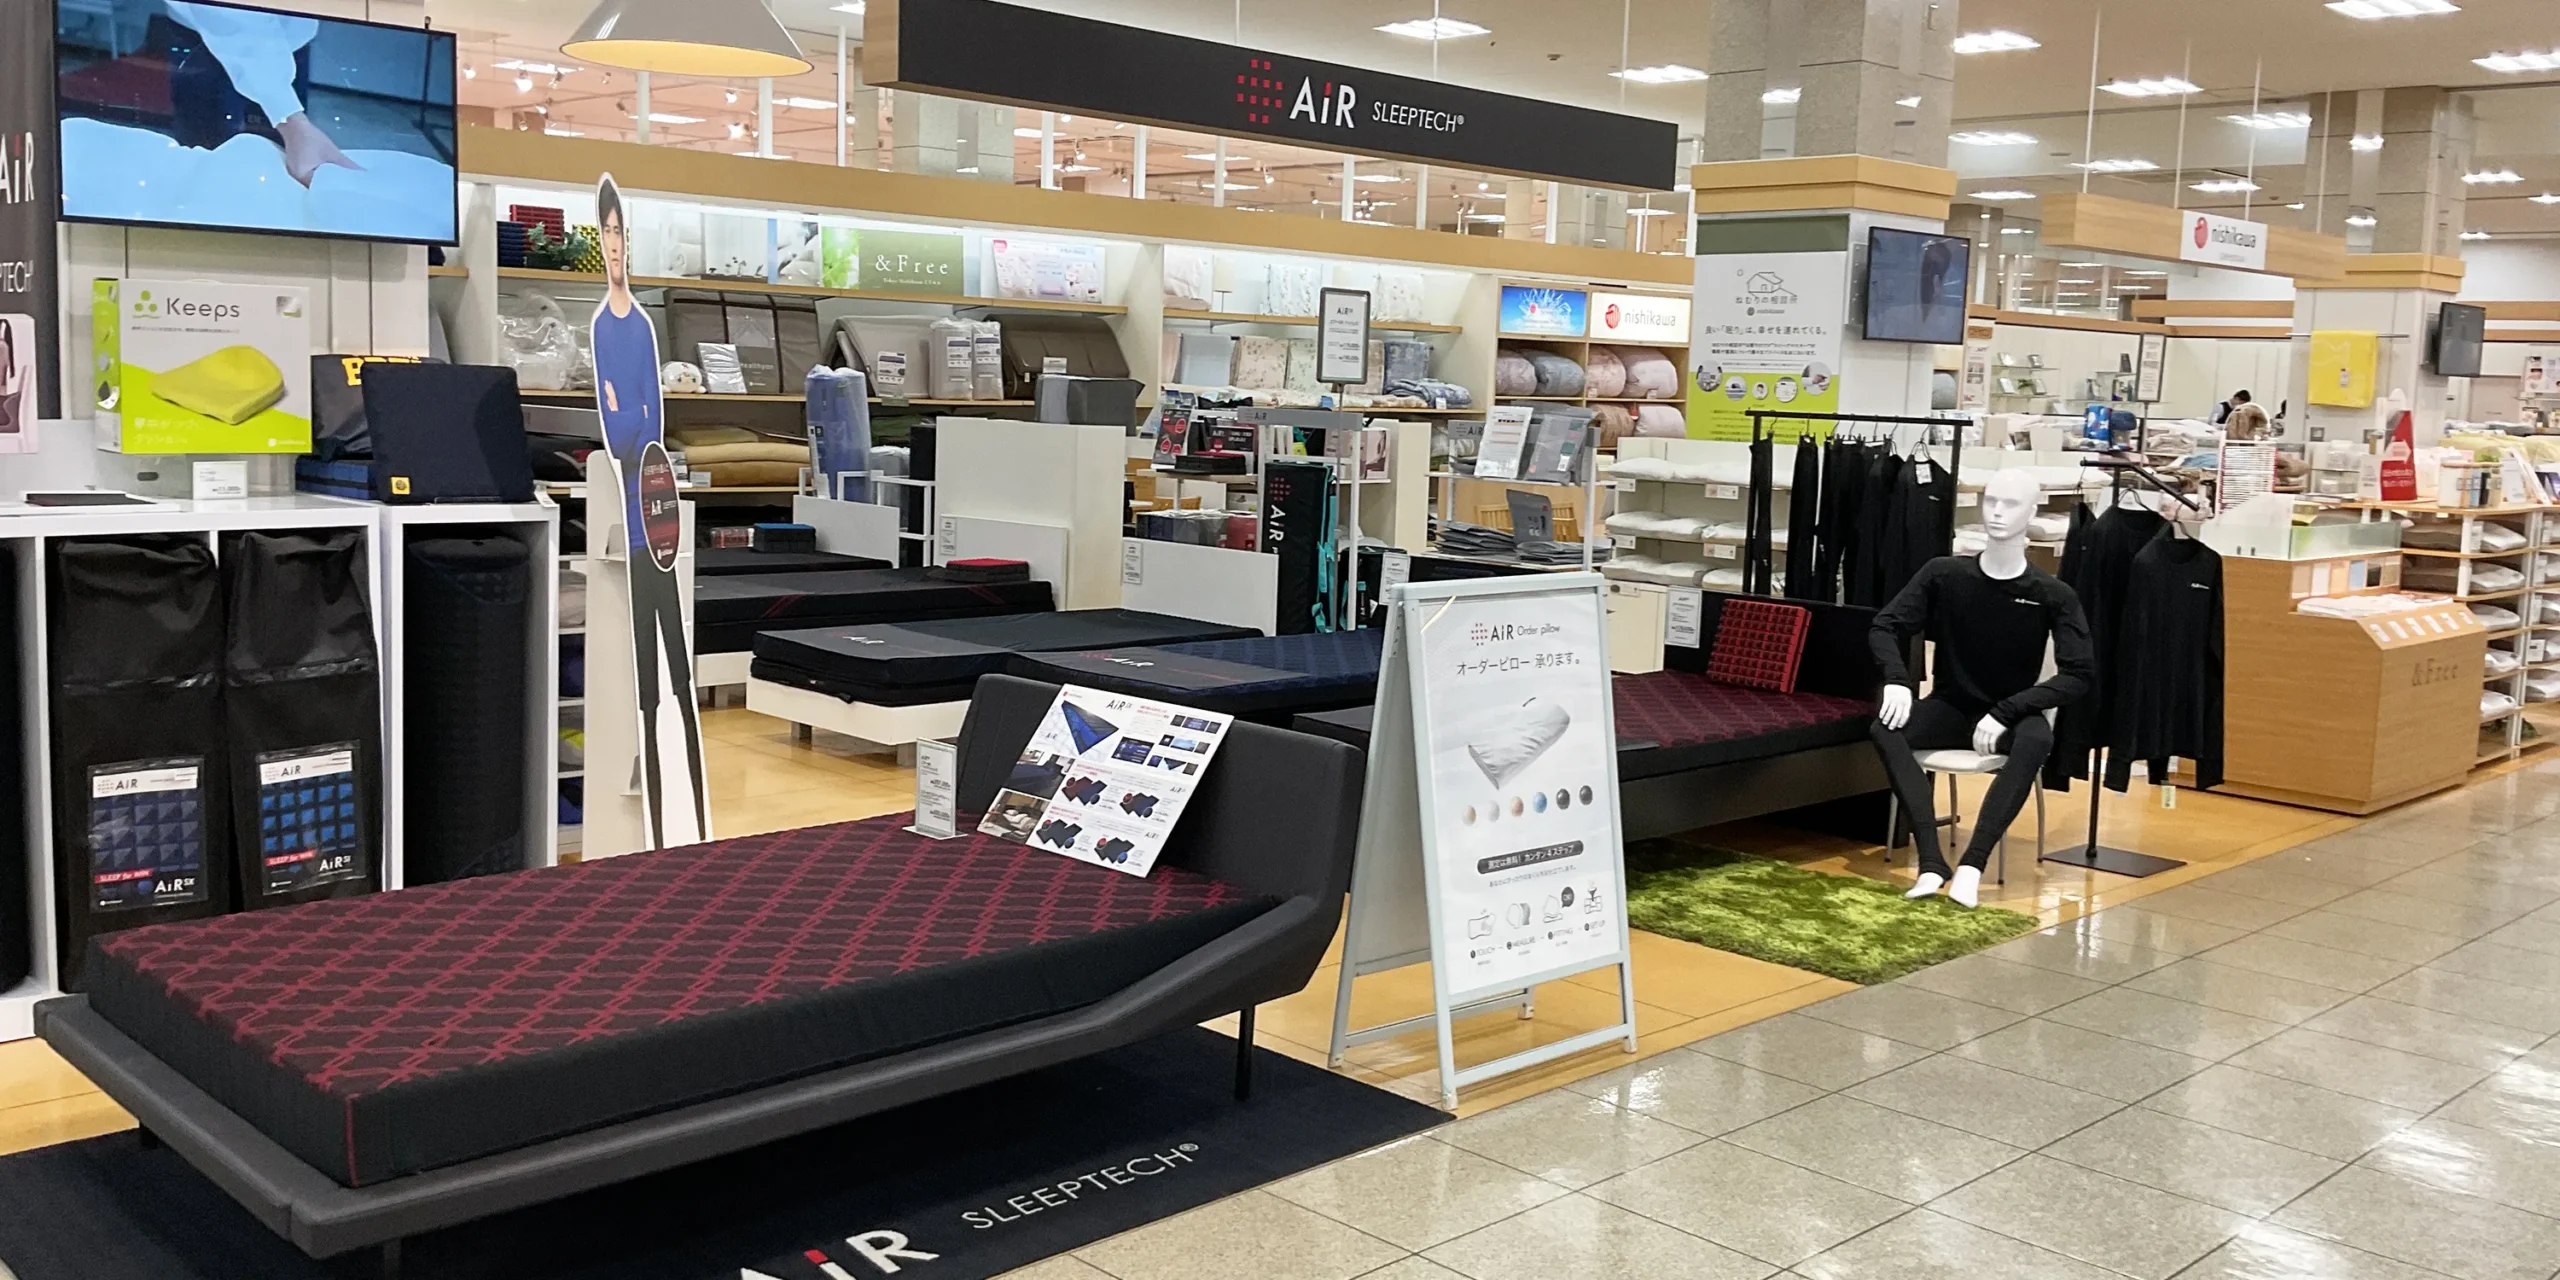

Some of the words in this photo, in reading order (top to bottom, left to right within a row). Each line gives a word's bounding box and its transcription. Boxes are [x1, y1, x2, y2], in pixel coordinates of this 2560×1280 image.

[1289, 76, 1356, 128] AiR
[2212, 224, 2256, 248] nishikawa
[166, 297, 240, 322] Keeps
[1624, 310, 1676, 327] nishikawa
[1269, 504, 1286, 542] AiR
[1490, 624, 1514, 642] AiR
[1517, 625, 1538, 637] Order
[1540, 623, 1561, 637] pillow
[1457, 656, 1530, 676] オーダーピロー
[1535, 651, 1581, 669] 承ります。
[1106, 699, 1126, 711] AiR
[281, 765, 301, 777] AiR
[115, 778, 138, 791] AiR
[319, 856, 343, 871] AiR
[154, 878, 183, 894] AiR
[740, 1229, 940, 1280] iR
